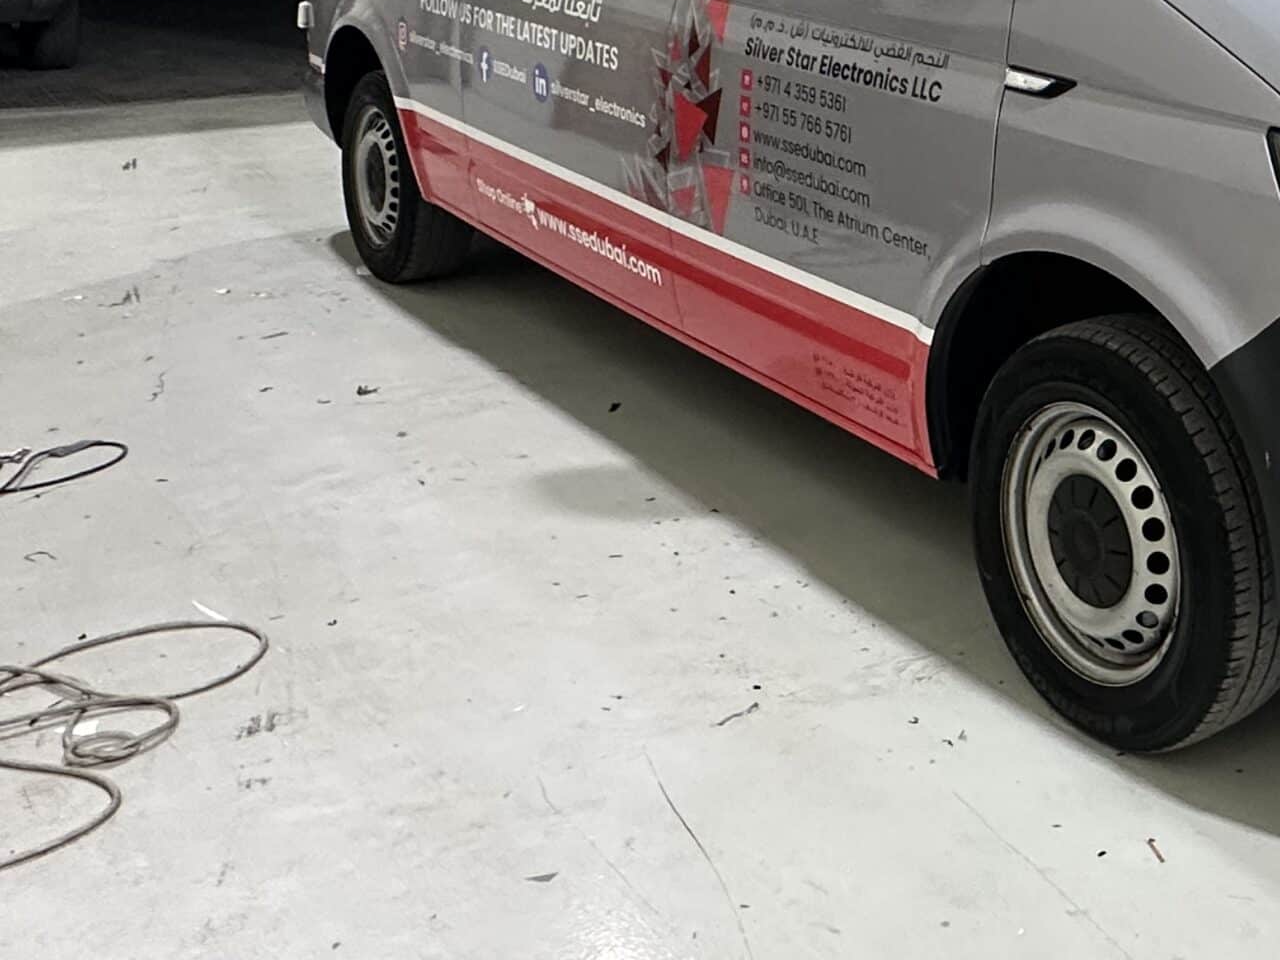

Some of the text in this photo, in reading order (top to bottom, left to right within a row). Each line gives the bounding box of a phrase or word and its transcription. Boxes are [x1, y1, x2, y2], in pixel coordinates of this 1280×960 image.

[460, 2, 472, 25] US
[473, 7, 494, 31] FOR
[496, 12, 515, 38] THE
[517, 17, 558, 51] LATEST
[560, 30, 619, 71] UPDATES
[745, 36, 943, 102] Silver Star Electronics LLC
[757, 74, 846, 113] +971 4 359 5361
[754, 102, 852, 144] +971 55 766 5761
[753, 129, 866, 177] www.ssedubai.com
[753, 155, 870, 208] info@ssedubai.com
[754, 181, 786, 206] Office
[812, 201, 834, 223] The
[838, 211, 878, 239] Atrium
[537, 208, 662, 287] www.ssedubai.com
